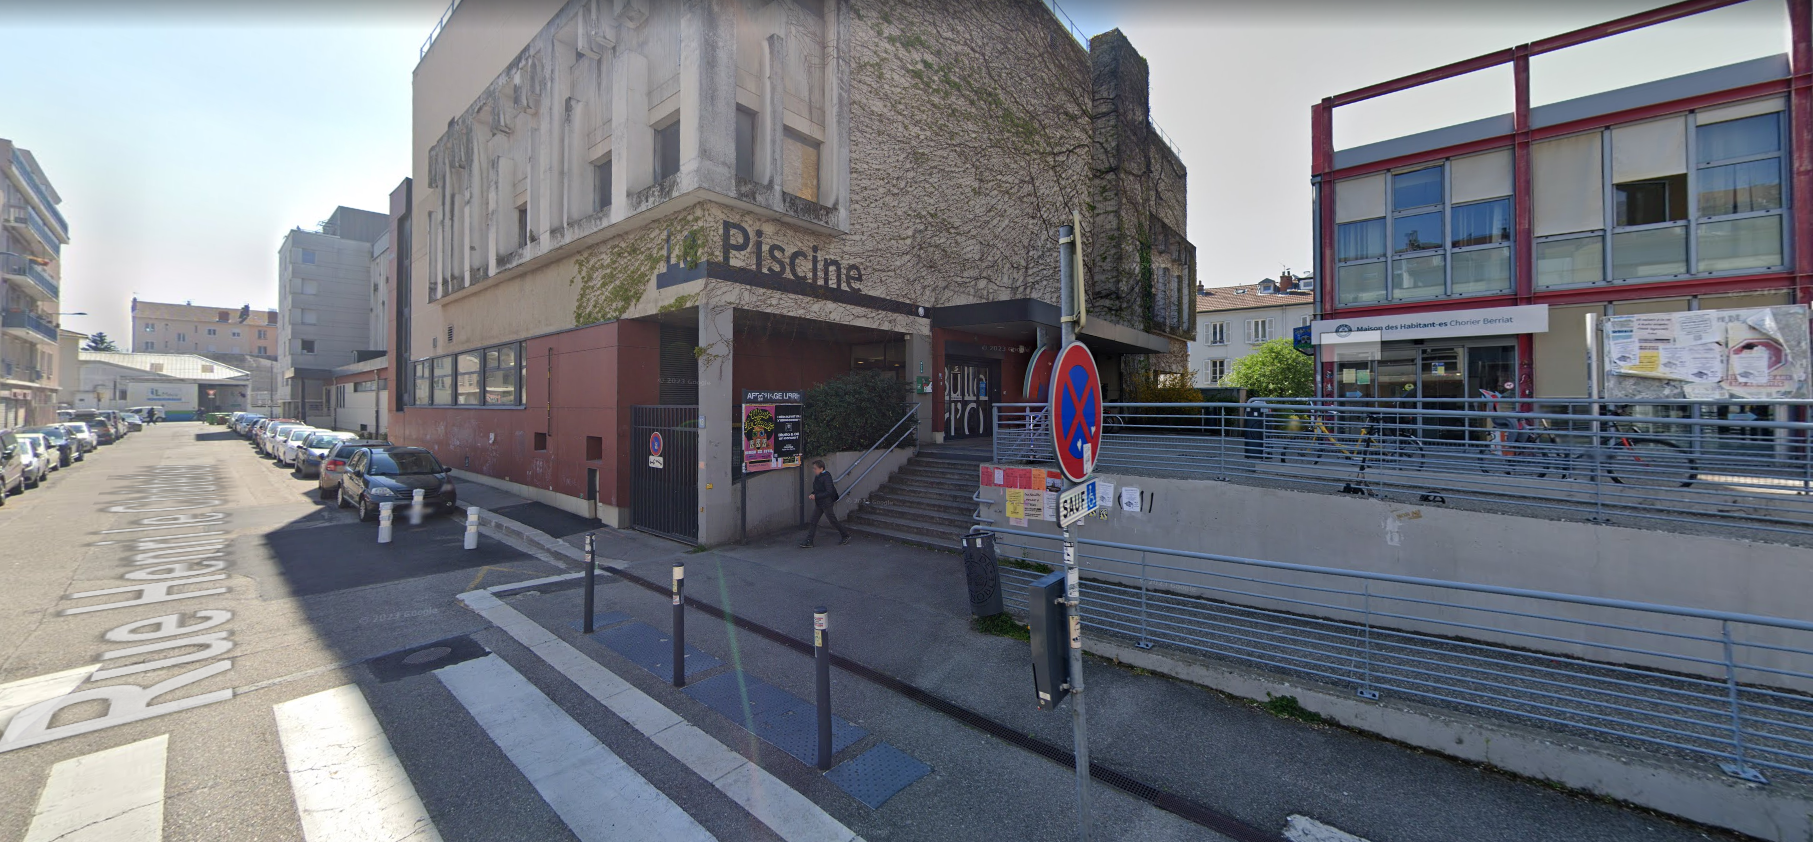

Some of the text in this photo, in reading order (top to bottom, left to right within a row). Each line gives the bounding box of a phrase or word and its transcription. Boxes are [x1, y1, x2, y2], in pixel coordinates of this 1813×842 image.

[722, 219, 864, 292] Piscine
[1356, 325, 1384, 333] Maison
[1384, 323, 1399, 331] des
[1449, 319, 1481, 327] Chorier
[1483, 316, 1513, 325] Berriat
[1062, 490, 1086, 519] SAUF
